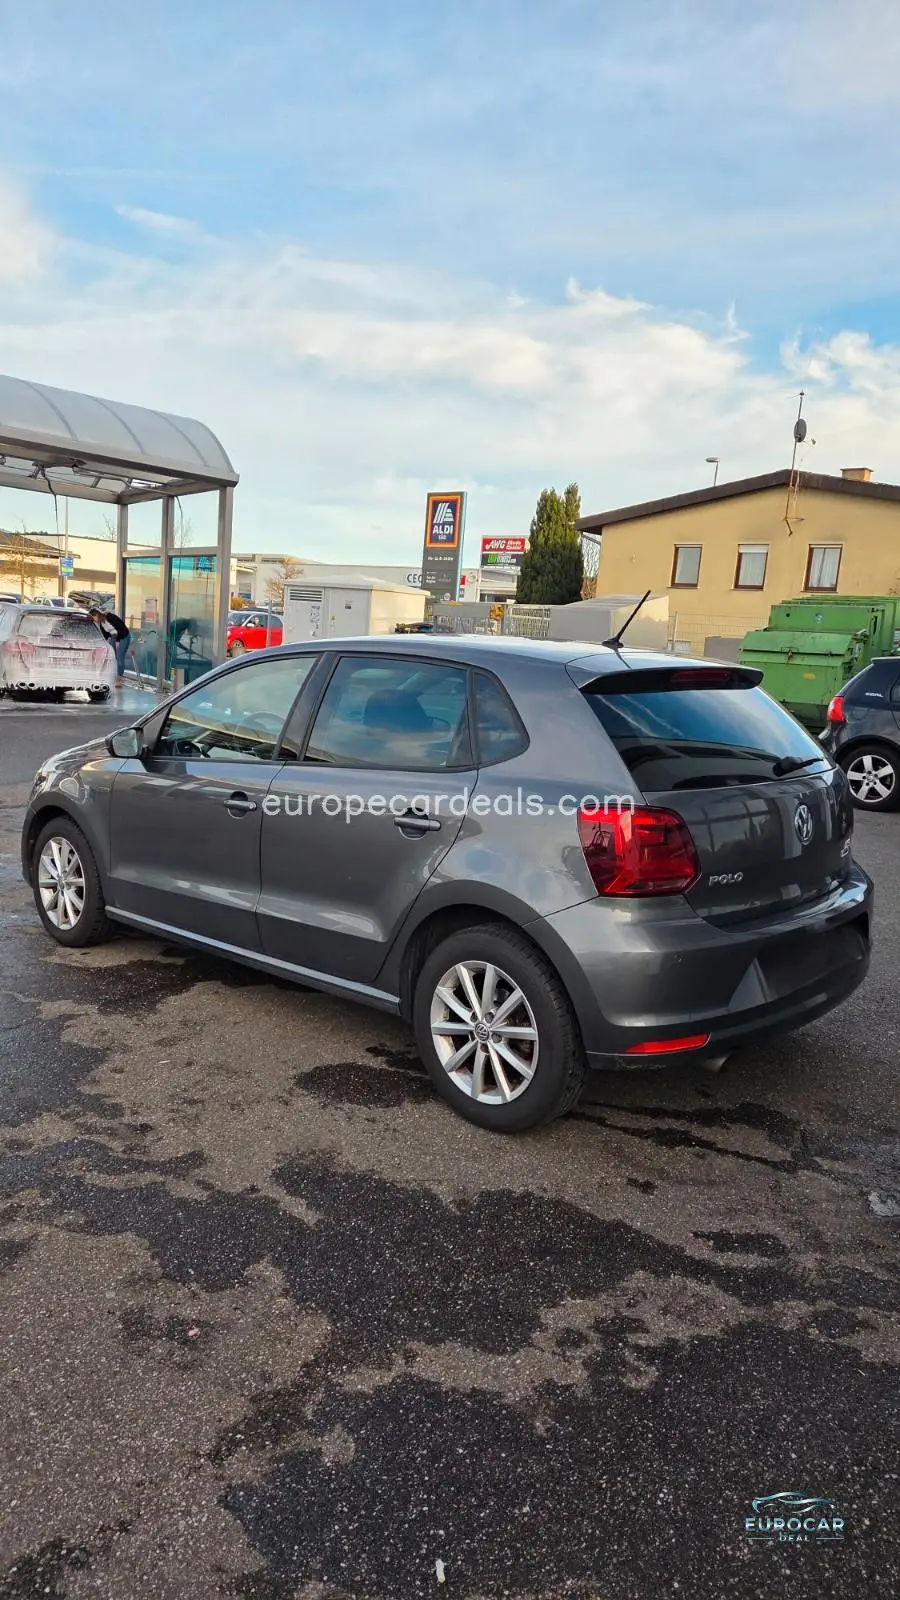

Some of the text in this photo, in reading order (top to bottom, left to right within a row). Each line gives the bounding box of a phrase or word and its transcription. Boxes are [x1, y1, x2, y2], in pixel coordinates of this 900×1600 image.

[433, 525, 453, 535] ALDI
[485, 540, 506, 550] AWG
[708, 871, 744, 886] POLO
